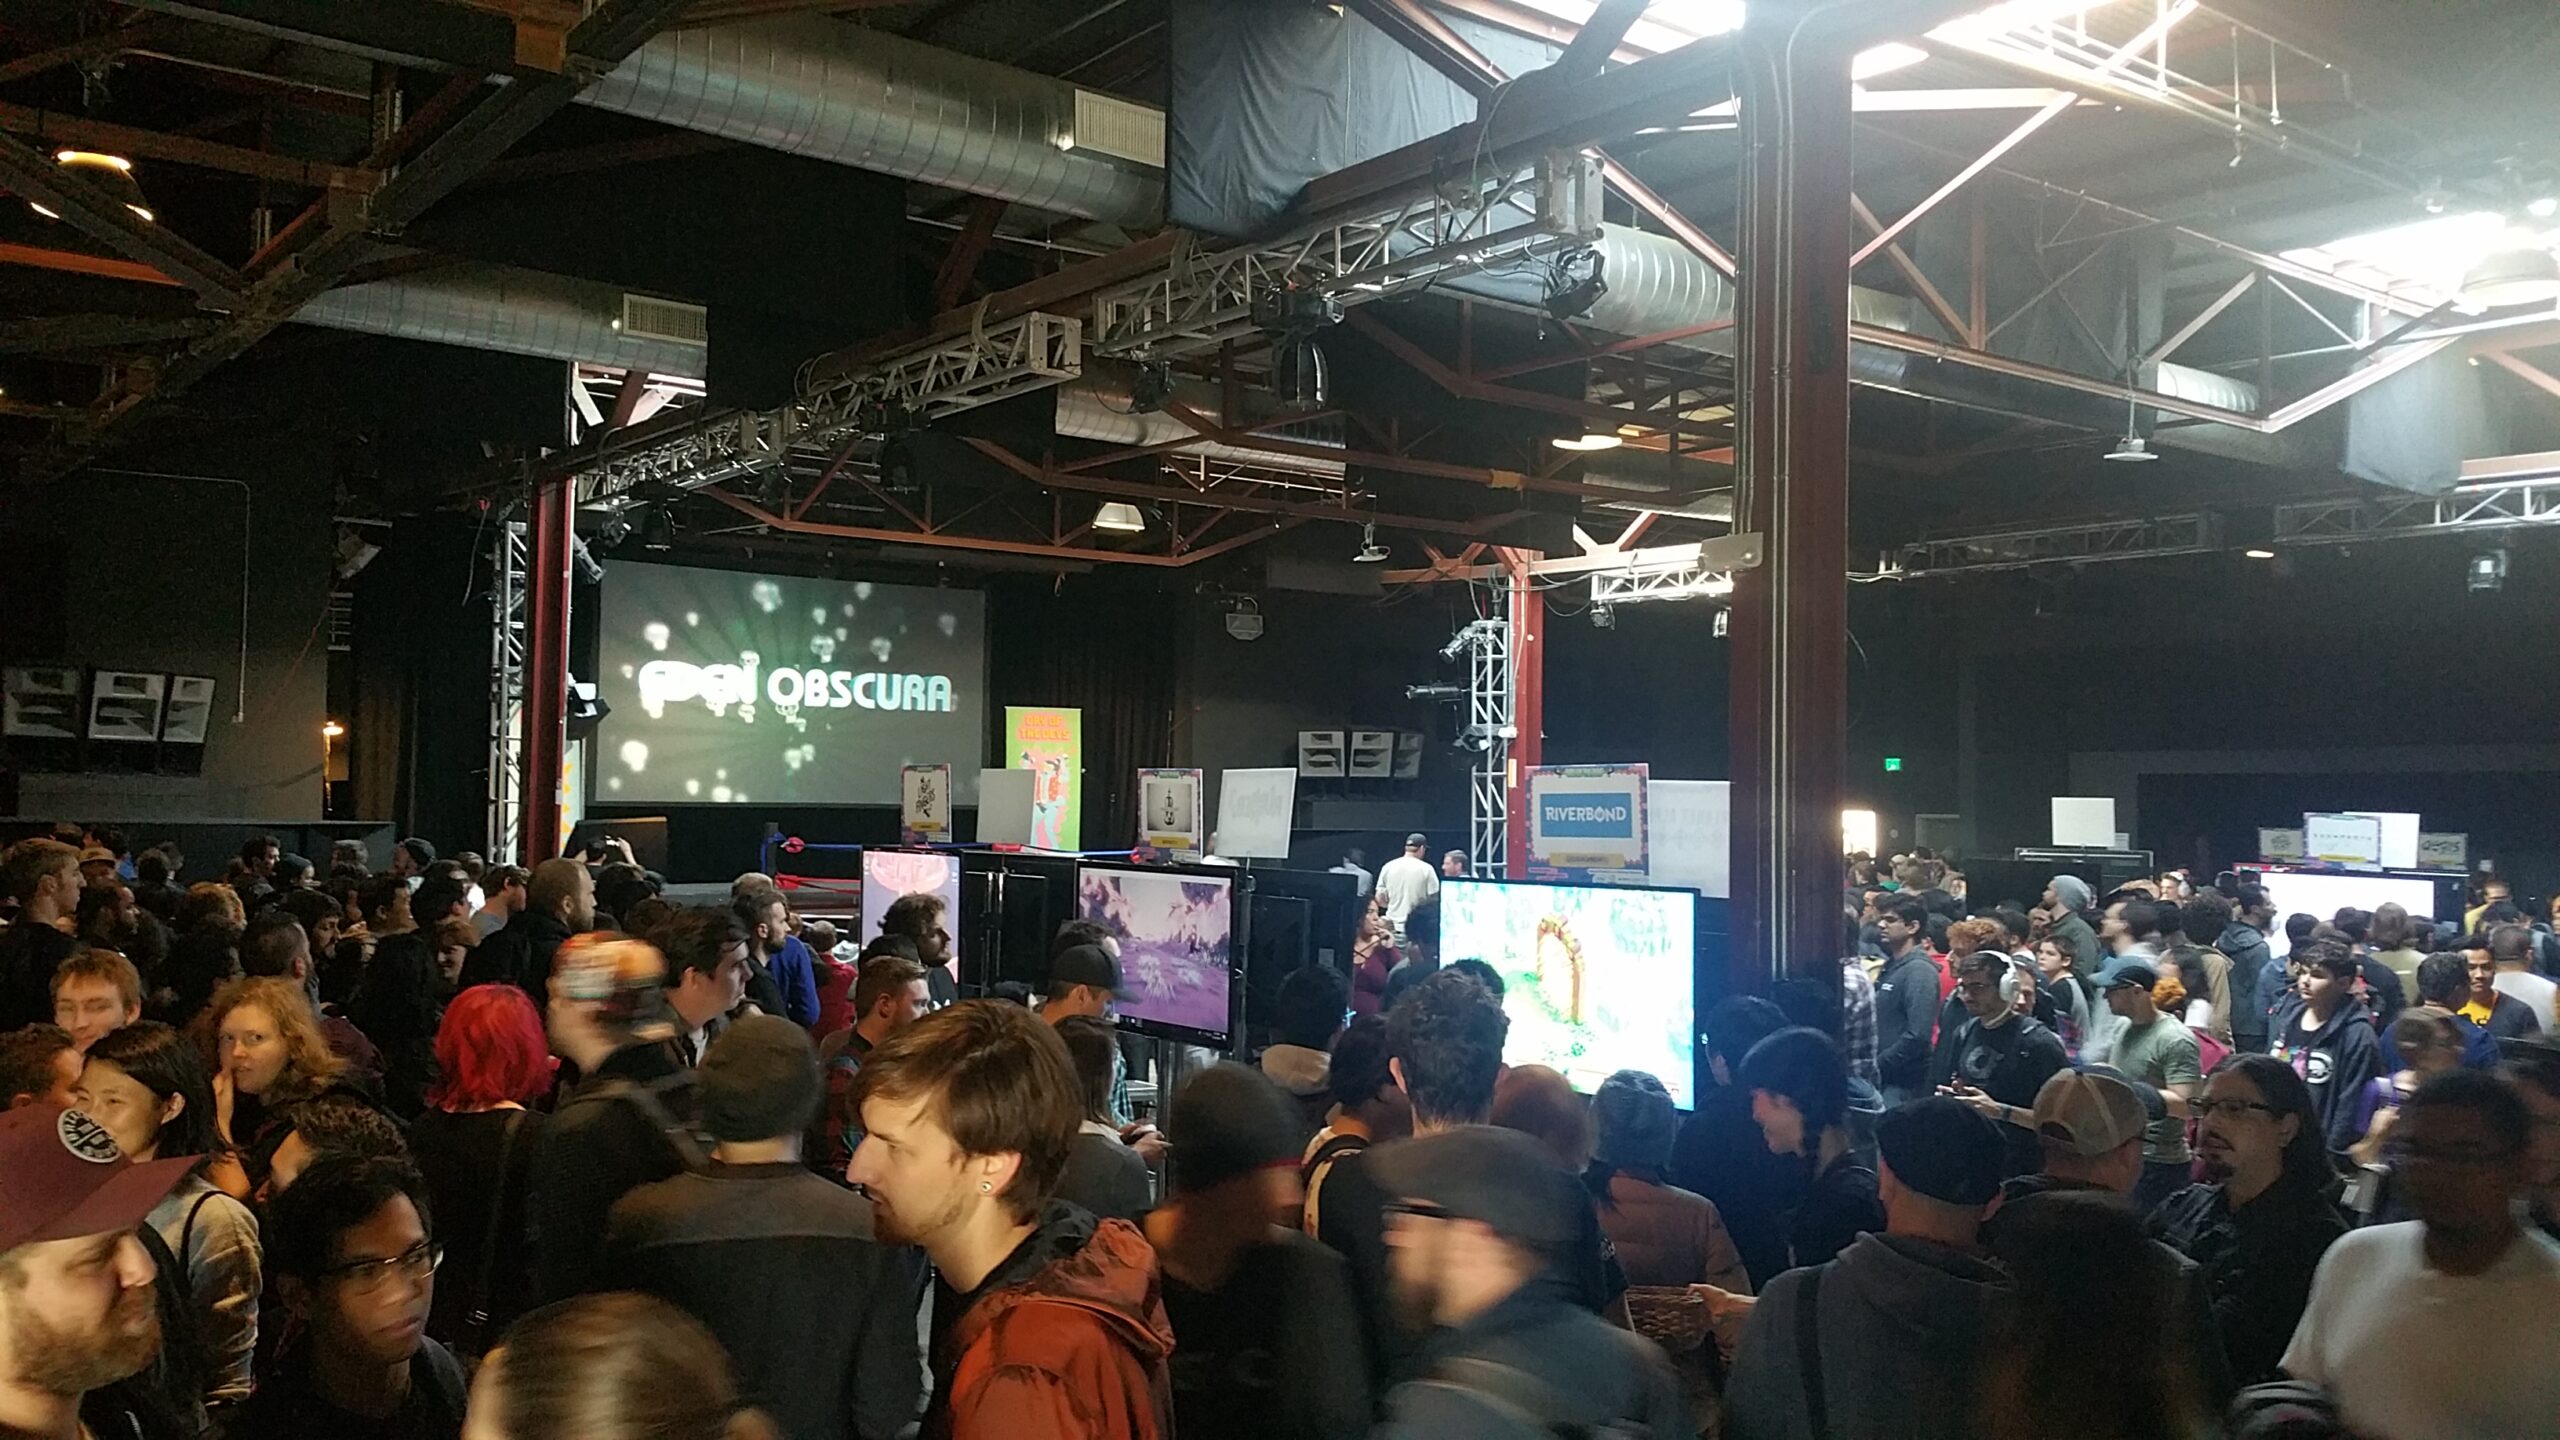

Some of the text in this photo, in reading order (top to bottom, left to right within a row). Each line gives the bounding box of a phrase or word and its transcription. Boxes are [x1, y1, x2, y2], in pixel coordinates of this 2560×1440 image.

[767, 667, 952, 712] OBSCURA
[1048, 715, 1063, 727] OF
[1545, 805, 1627, 822] RIVERBOND
